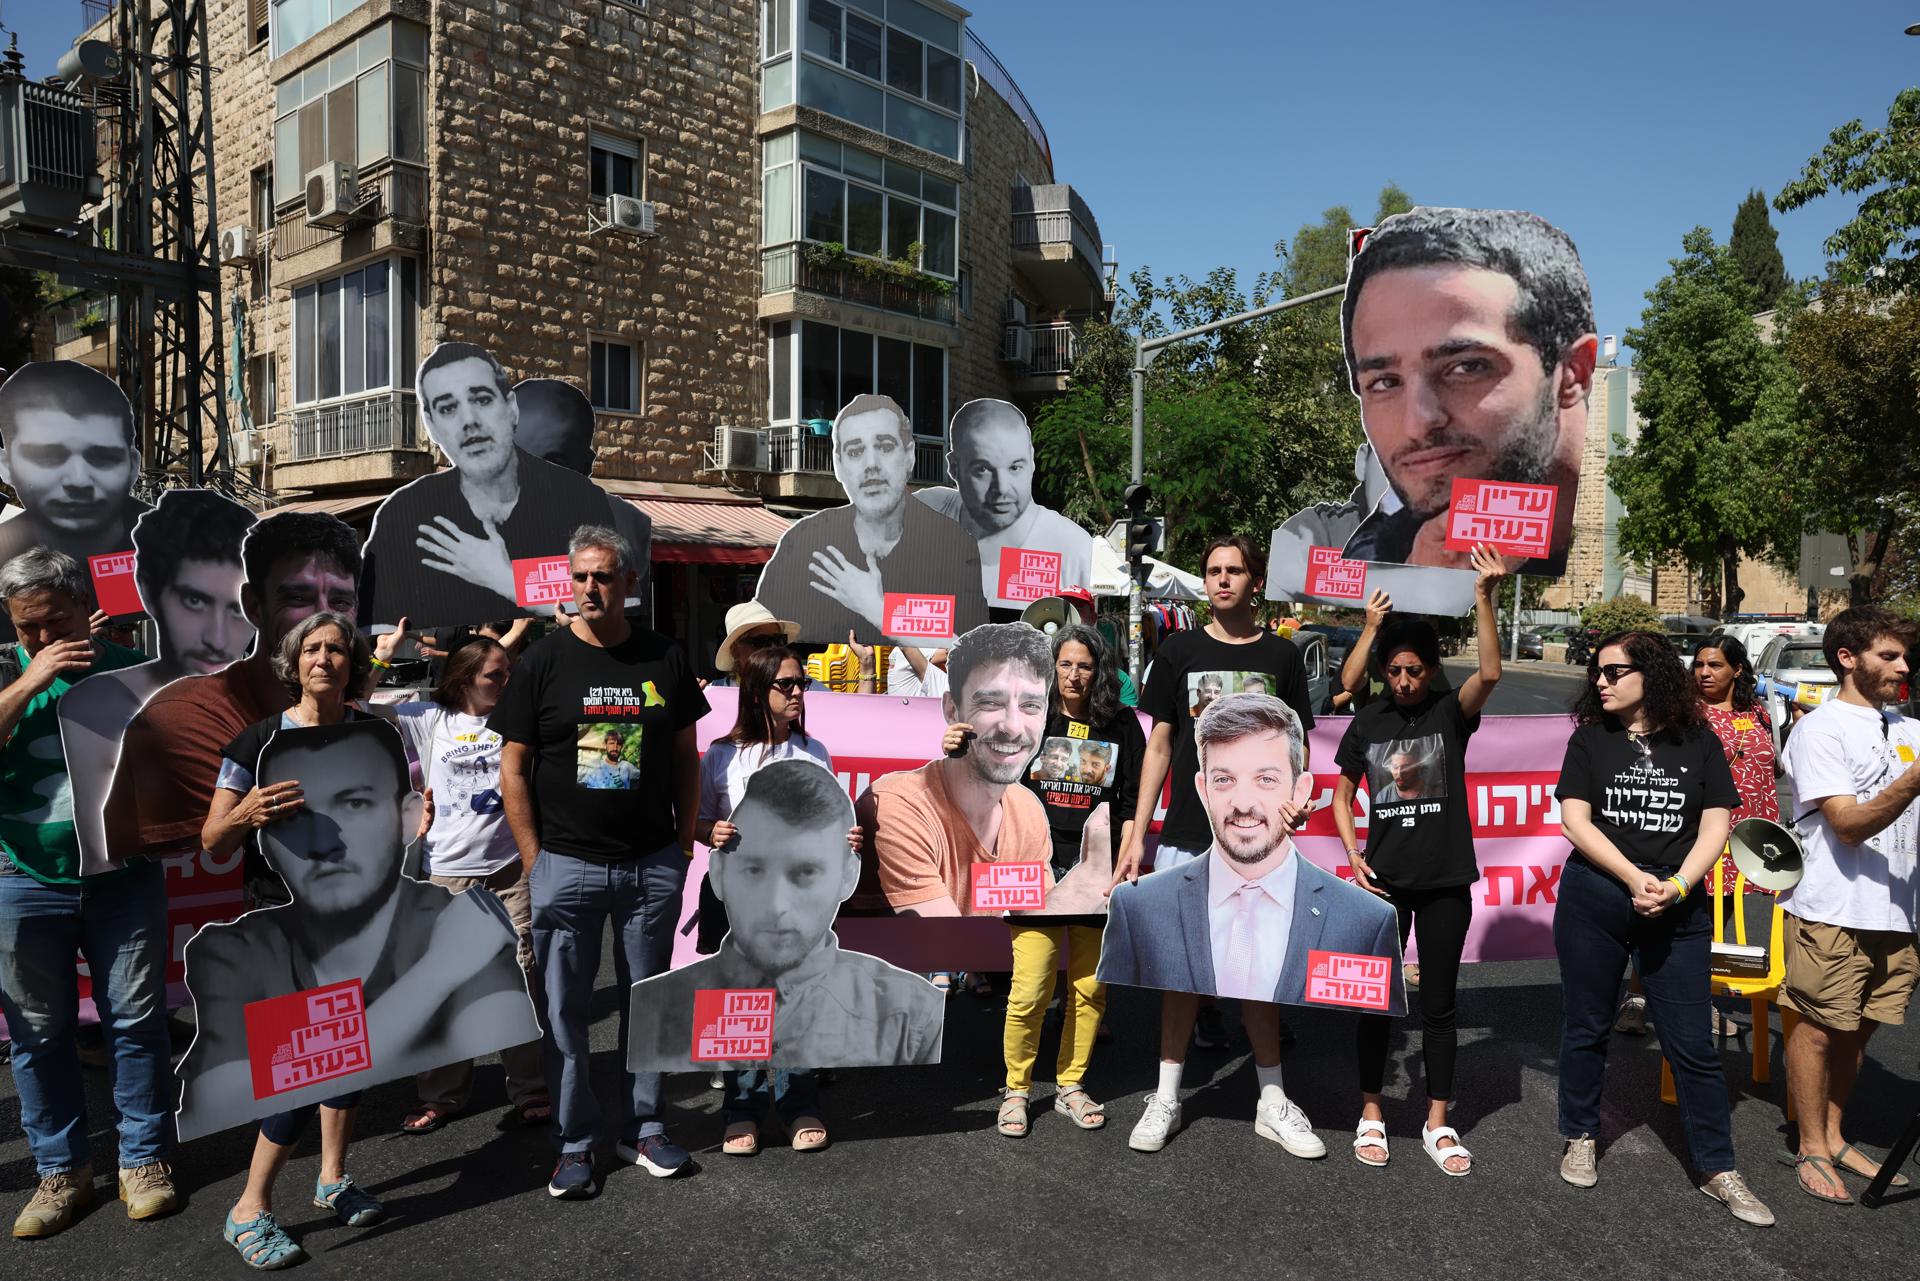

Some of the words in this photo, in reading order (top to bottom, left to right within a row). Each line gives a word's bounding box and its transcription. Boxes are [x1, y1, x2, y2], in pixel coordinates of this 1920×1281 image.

[1482, 488, 1548, 512] עדיין
[1462, 517, 1543, 542] בעזה.
[1024, 554, 1055, 568] איתן
[541, 562, 571, 580] דיין
[1022, 570, 1055, 583] עדיין
[1330, 567, 1361, 579] עדיין
[534, 582, 573, 599] עזה.
[1320, 582, 1359, 594] בעזה.
[909, 600, 947, 615] עדיין
[897, 618, 946, 632] בעזה.
[583, 697, 602, 706] חמאס
[603, 697, 613, 706] ידי
[614, 696, 623, 706] על
[624, 697, 640, 706] נרצח
[1070, 724, 1088, 737] 711
[441, 745, 469, 763] BRING
[1614, 772, 1646, 785] גדולה
[1650, 777, 1679, 786] מצוה
[1606, 787, 1685, 811] כפדיון
[1376, 805, 1417, 819] צנגאוקר
[1420, 802, 1441, 815] מתן
[1401, 817, 1415, 827] 25
[994, 867, 1038, 885] עדיין
[983, 889, 1040, 905] בעזה.
[1333, 958, 1384, 978] עדיין
[1318, 981, 1382, 1003] בעזה.
[315, 991, 357, 1017] בר
[729, 995, 769, 1013] מתן
[720, 1018, 768, 1035] עדיין
[296, 1016, 360, 1054] עדיין
[707, 1039, 766, 1054] בעזה.
[285, 1044, 365, 1085] בעזה.
